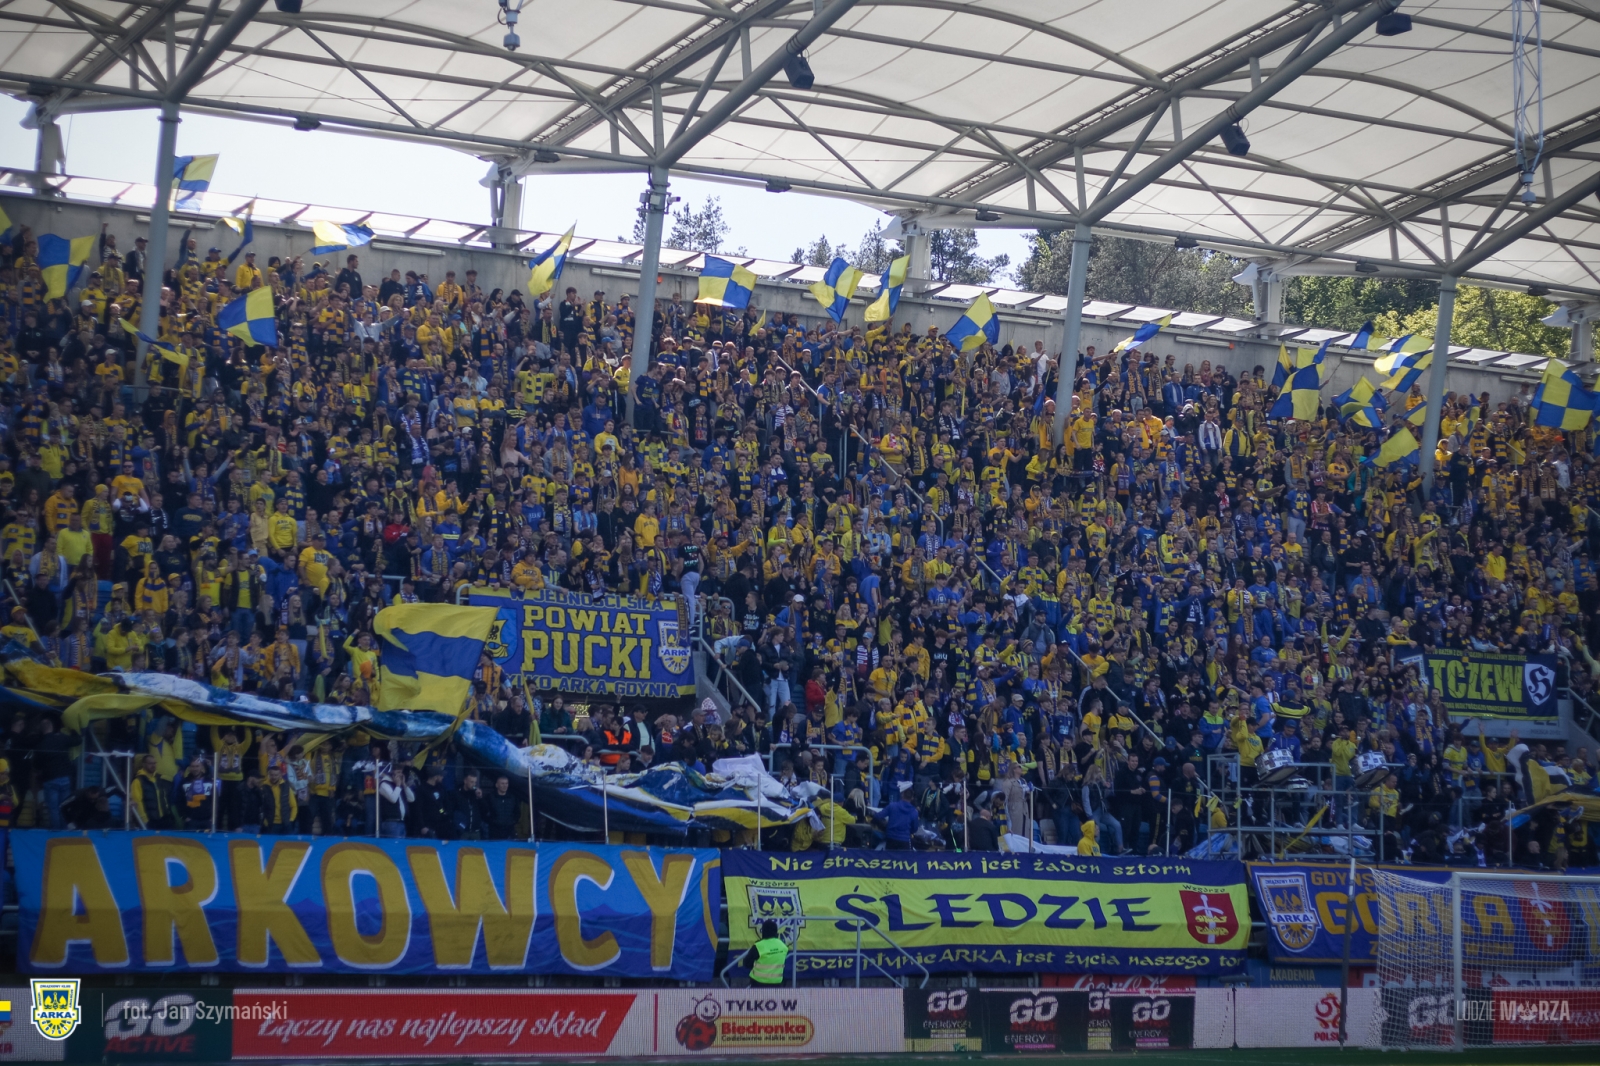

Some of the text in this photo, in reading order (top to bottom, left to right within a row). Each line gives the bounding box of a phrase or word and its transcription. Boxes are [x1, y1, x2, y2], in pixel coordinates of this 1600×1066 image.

[523, 605, 651, 635] POWIAT
[521, 629, 652, 679] PUCKI
[509, 673, 681, 698] YLKO ARKA GDYNIA
[1428, 659, 1523, 702] TCZEW
[769, 855, 1191, 876] Nie straszny nam jest żaden sztorm
[30, 837, 697, 971] ARKOWCY
[835, 885, 1161, 932] ŚLEDZIE
[1277, 914, 1311, 923] ARKA
[1015, 949, 1055, 966] jest
[1065, 952, 1120, 968] życia
[1129, 954, 1209, 969] naszego
[1270, 968, 1316, 981] AKADEMIA
[726, 1000, 798, 1012] TYLKO W
[927, 988, 968, 1013] GO
[1010, 996, 1058, 1024] GO
[1132, 1000, 1171, 1022] GO
[257, 1010, 607, 1047] Łączy nas najlepszy skład
[721, 1022, 806, 1035] Biedronka
[1314, 1031, 1348, 1041] POLS
